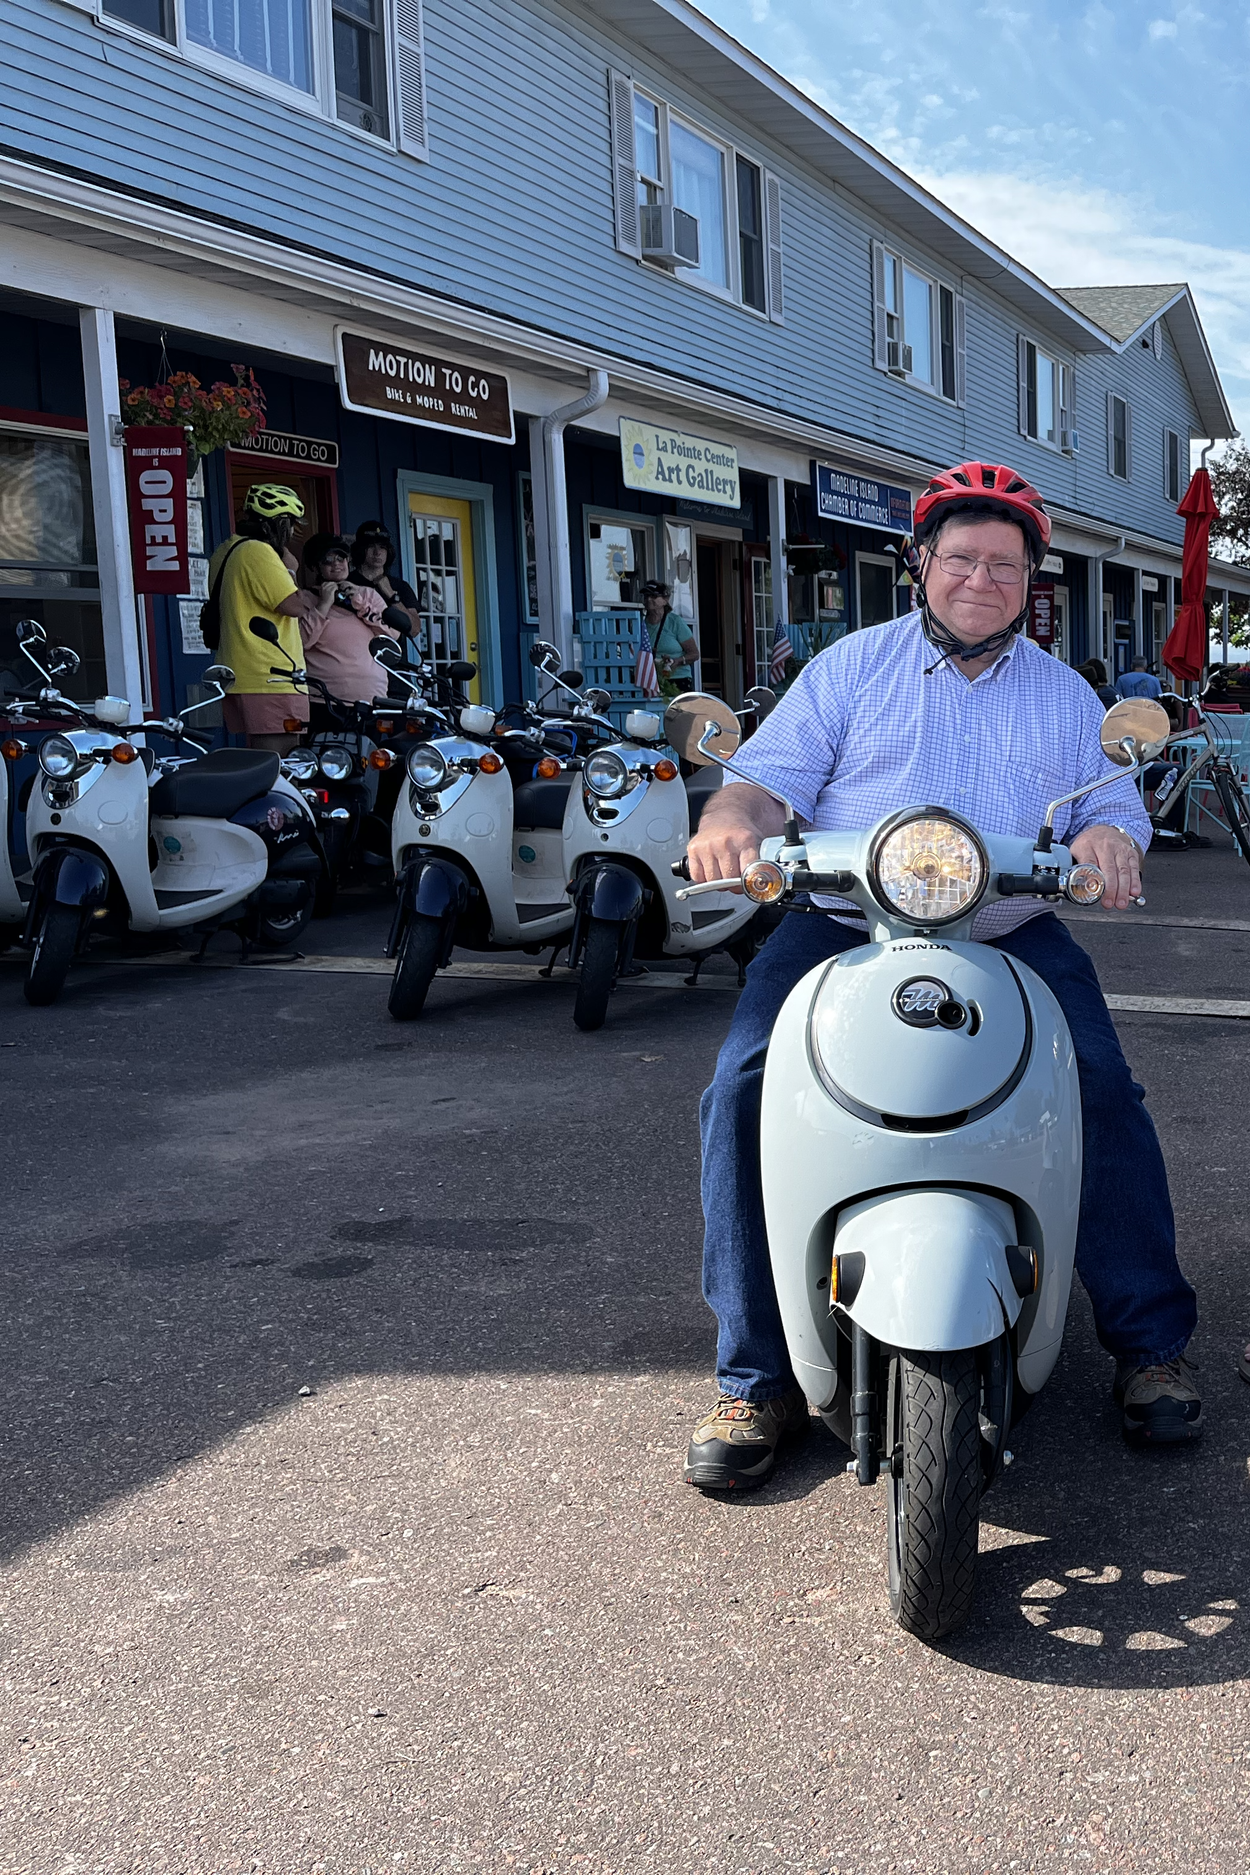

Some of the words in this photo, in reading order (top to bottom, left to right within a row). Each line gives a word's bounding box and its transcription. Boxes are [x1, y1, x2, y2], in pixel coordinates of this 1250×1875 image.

[368, 348, 436, 388] MOTION
[441, 367, 463, 393] TO
[468, 375, 490, 401] GO
[385, 386, 404, 402] BIKE
[406, 392, 412, 404] &
[416, 394, 444, 412] MOPED
[450, 402, 478, 420] RENTAL
[152, 457, 159, 467] IS
[160, 446, 182, 456] ISLAND
[240, 434, 289, 455] MOTION
[292, 442, 307, 457] TO
[310, 444, 328, 461] GO
[655, 434, 668, 454] La
[670, 438, 702, 462] Pointe
[704, 447, 735, 469] Center
[655, 456, 683, 485] Art
[685, 463, 737, 501] Gallery
[830, 473, 859, 497] MADELINE
[860, 480, 879, 502] ISLAND
[139, 469, 181, 571] OPEN
[820, 491, 849, 516] CHAMBER
[850, 499, 857, 517] OF
[858, 501, 889, 525] COMMERCE
[1034, 598, 1051, 636] OPEN
[892, 943, 953, 952] HONDA
